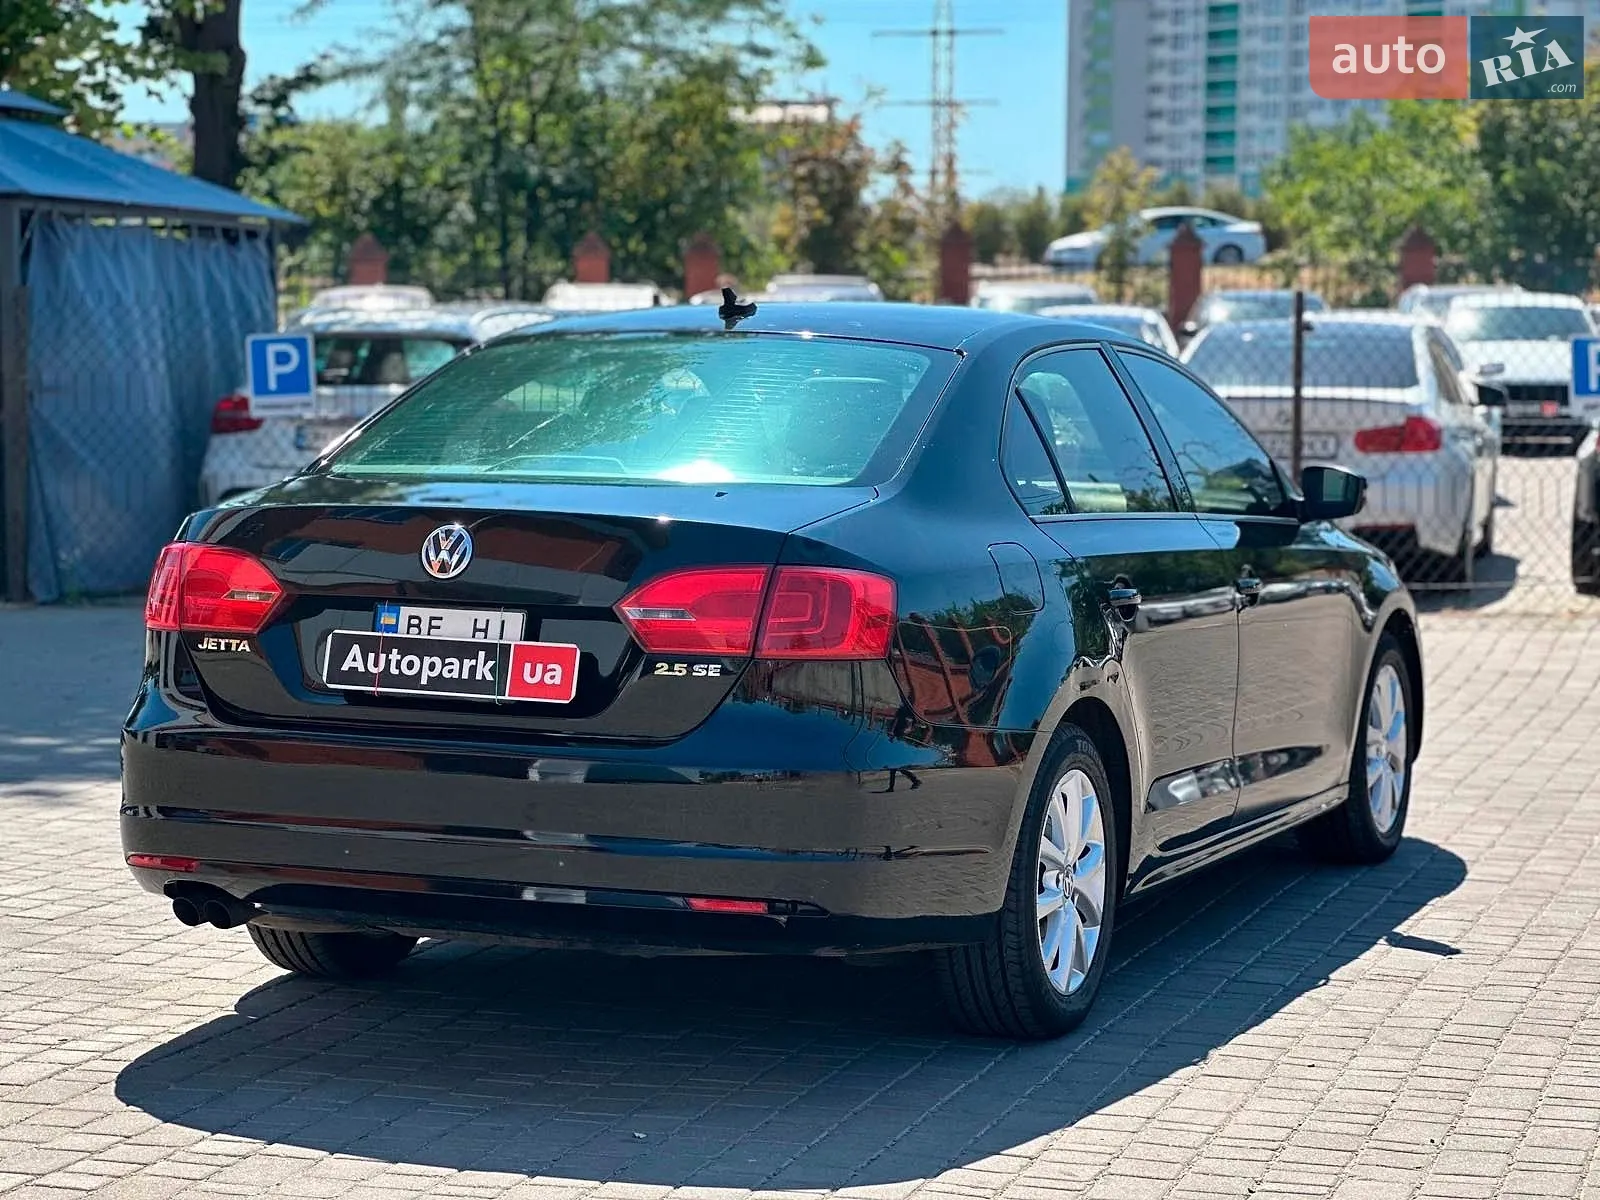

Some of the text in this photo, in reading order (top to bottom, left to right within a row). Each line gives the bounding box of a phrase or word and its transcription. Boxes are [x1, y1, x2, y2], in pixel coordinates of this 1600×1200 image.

[266, 343, 300, 392] P
[197, 637, 251, 652] JETTA
[341, 643, 562, 685] Autopark ua
[692, 663, 722, 677] SE
